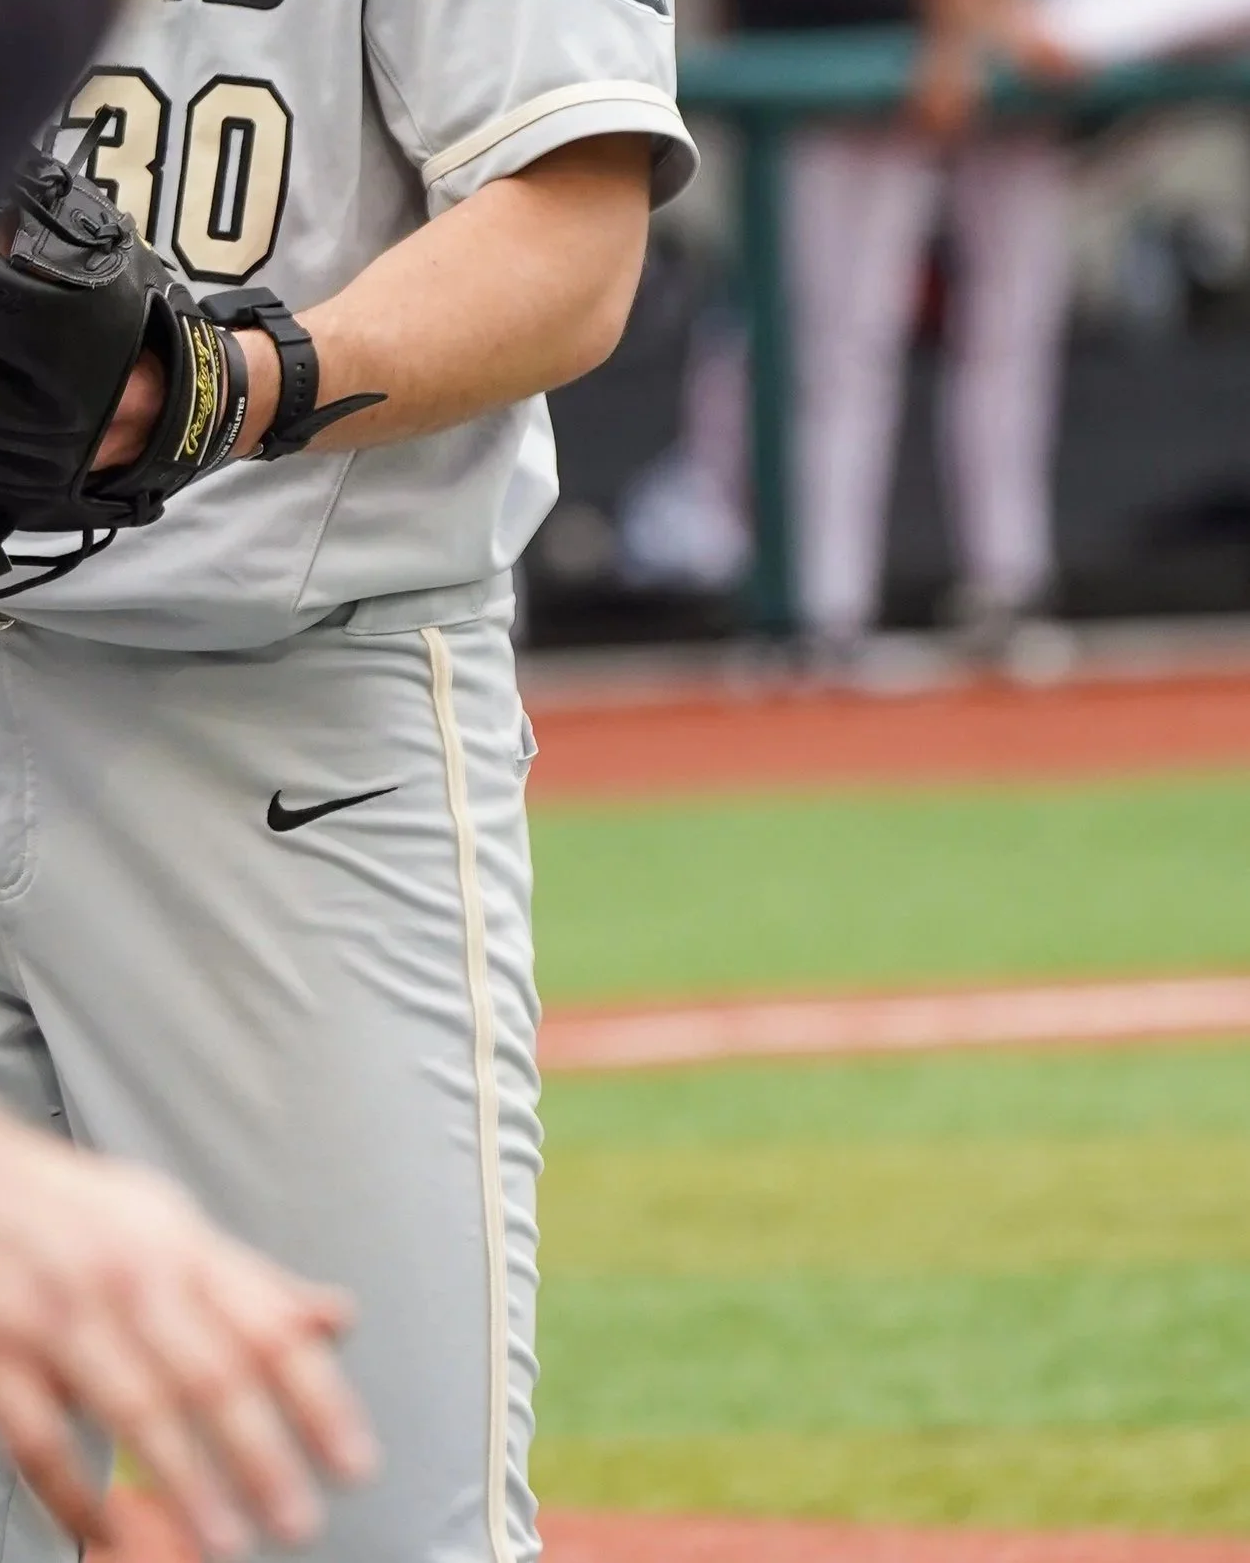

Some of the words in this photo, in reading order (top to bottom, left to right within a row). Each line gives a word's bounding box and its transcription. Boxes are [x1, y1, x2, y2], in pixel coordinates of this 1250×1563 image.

[61, 64, 294, 286] 30
[186, 326, 213, 455] Rawlings
[228, 396, 246, 444] ATHLETES
